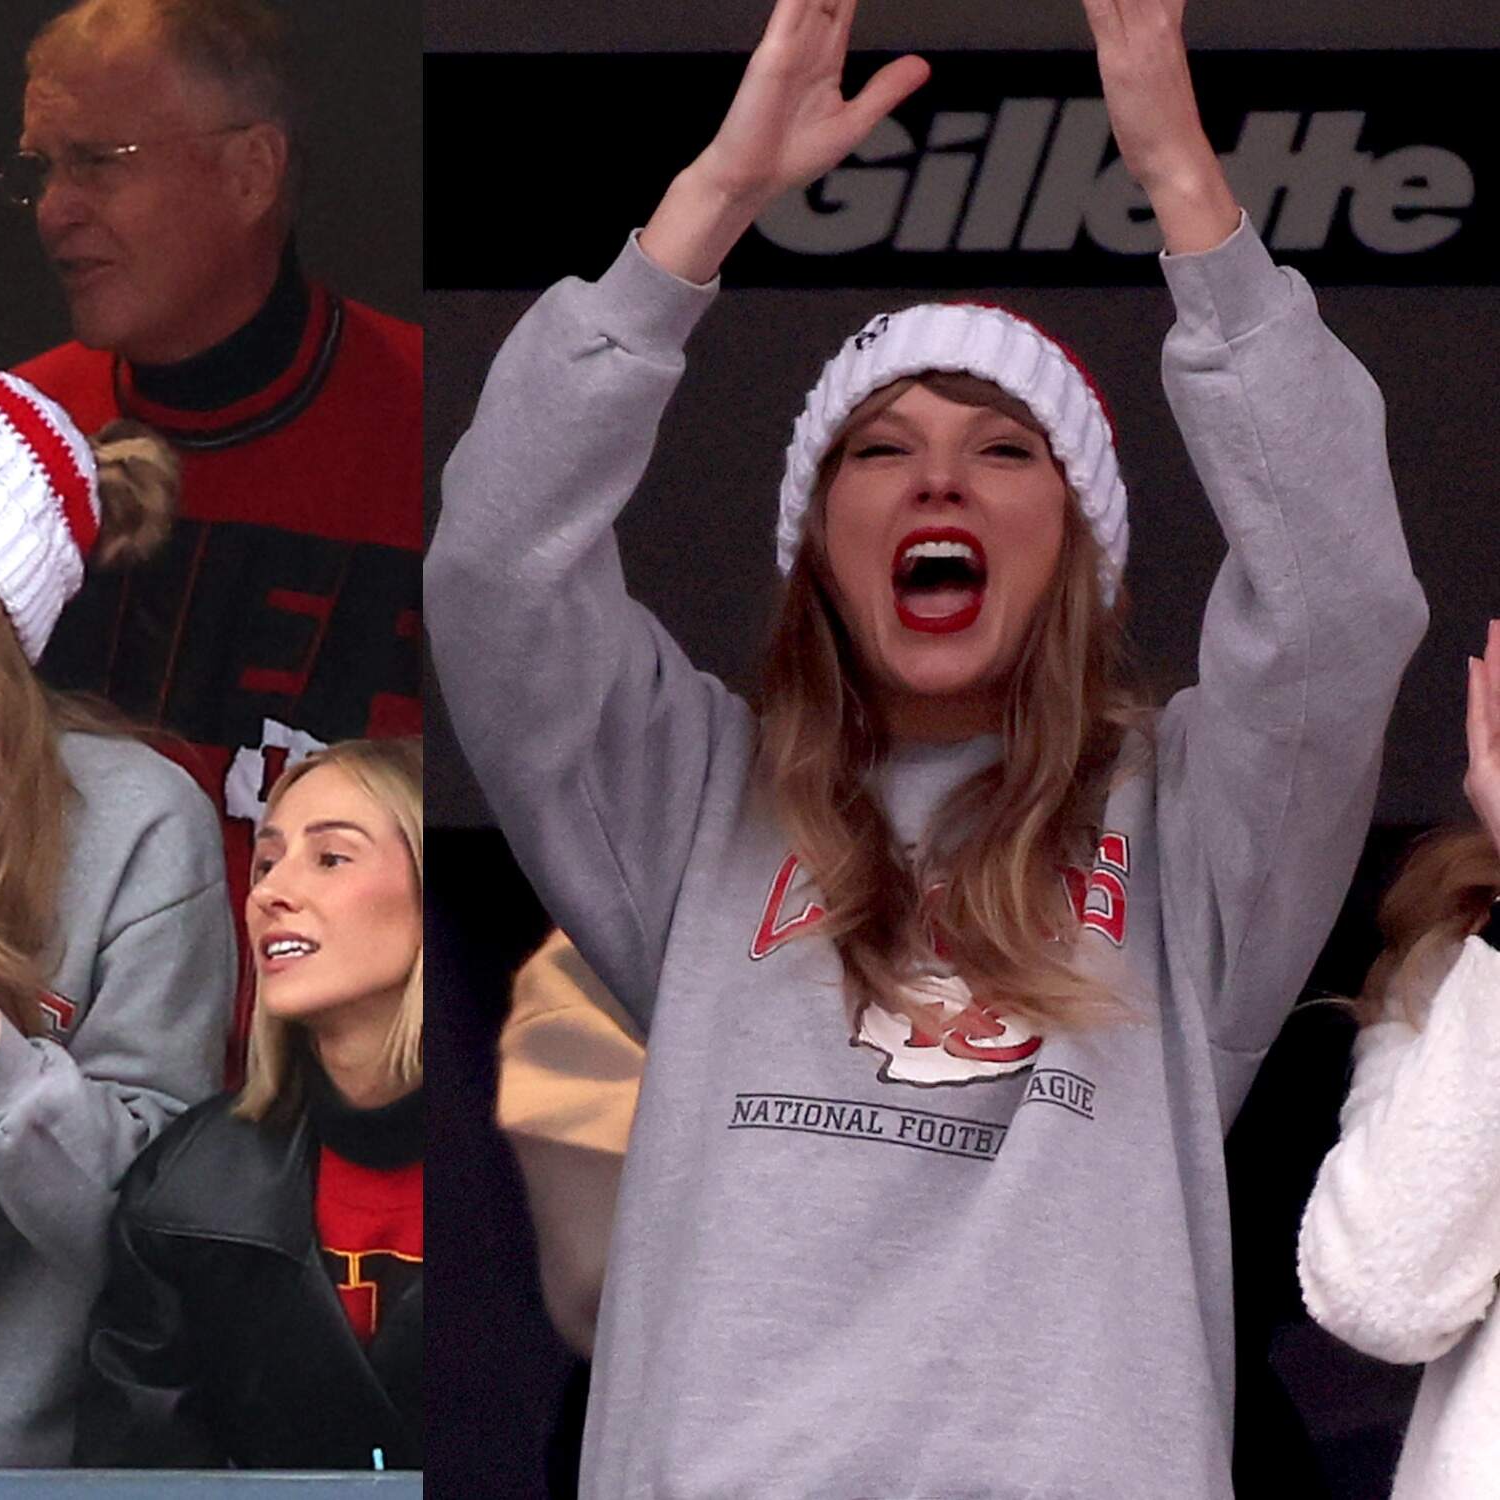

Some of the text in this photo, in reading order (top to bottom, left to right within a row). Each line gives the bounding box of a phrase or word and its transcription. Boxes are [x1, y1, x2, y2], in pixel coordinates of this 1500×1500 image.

[754, 97, 1475, 255] Gillette
[733, 1075, 1095, 1155] NATIONAL FOOTB AGUE
